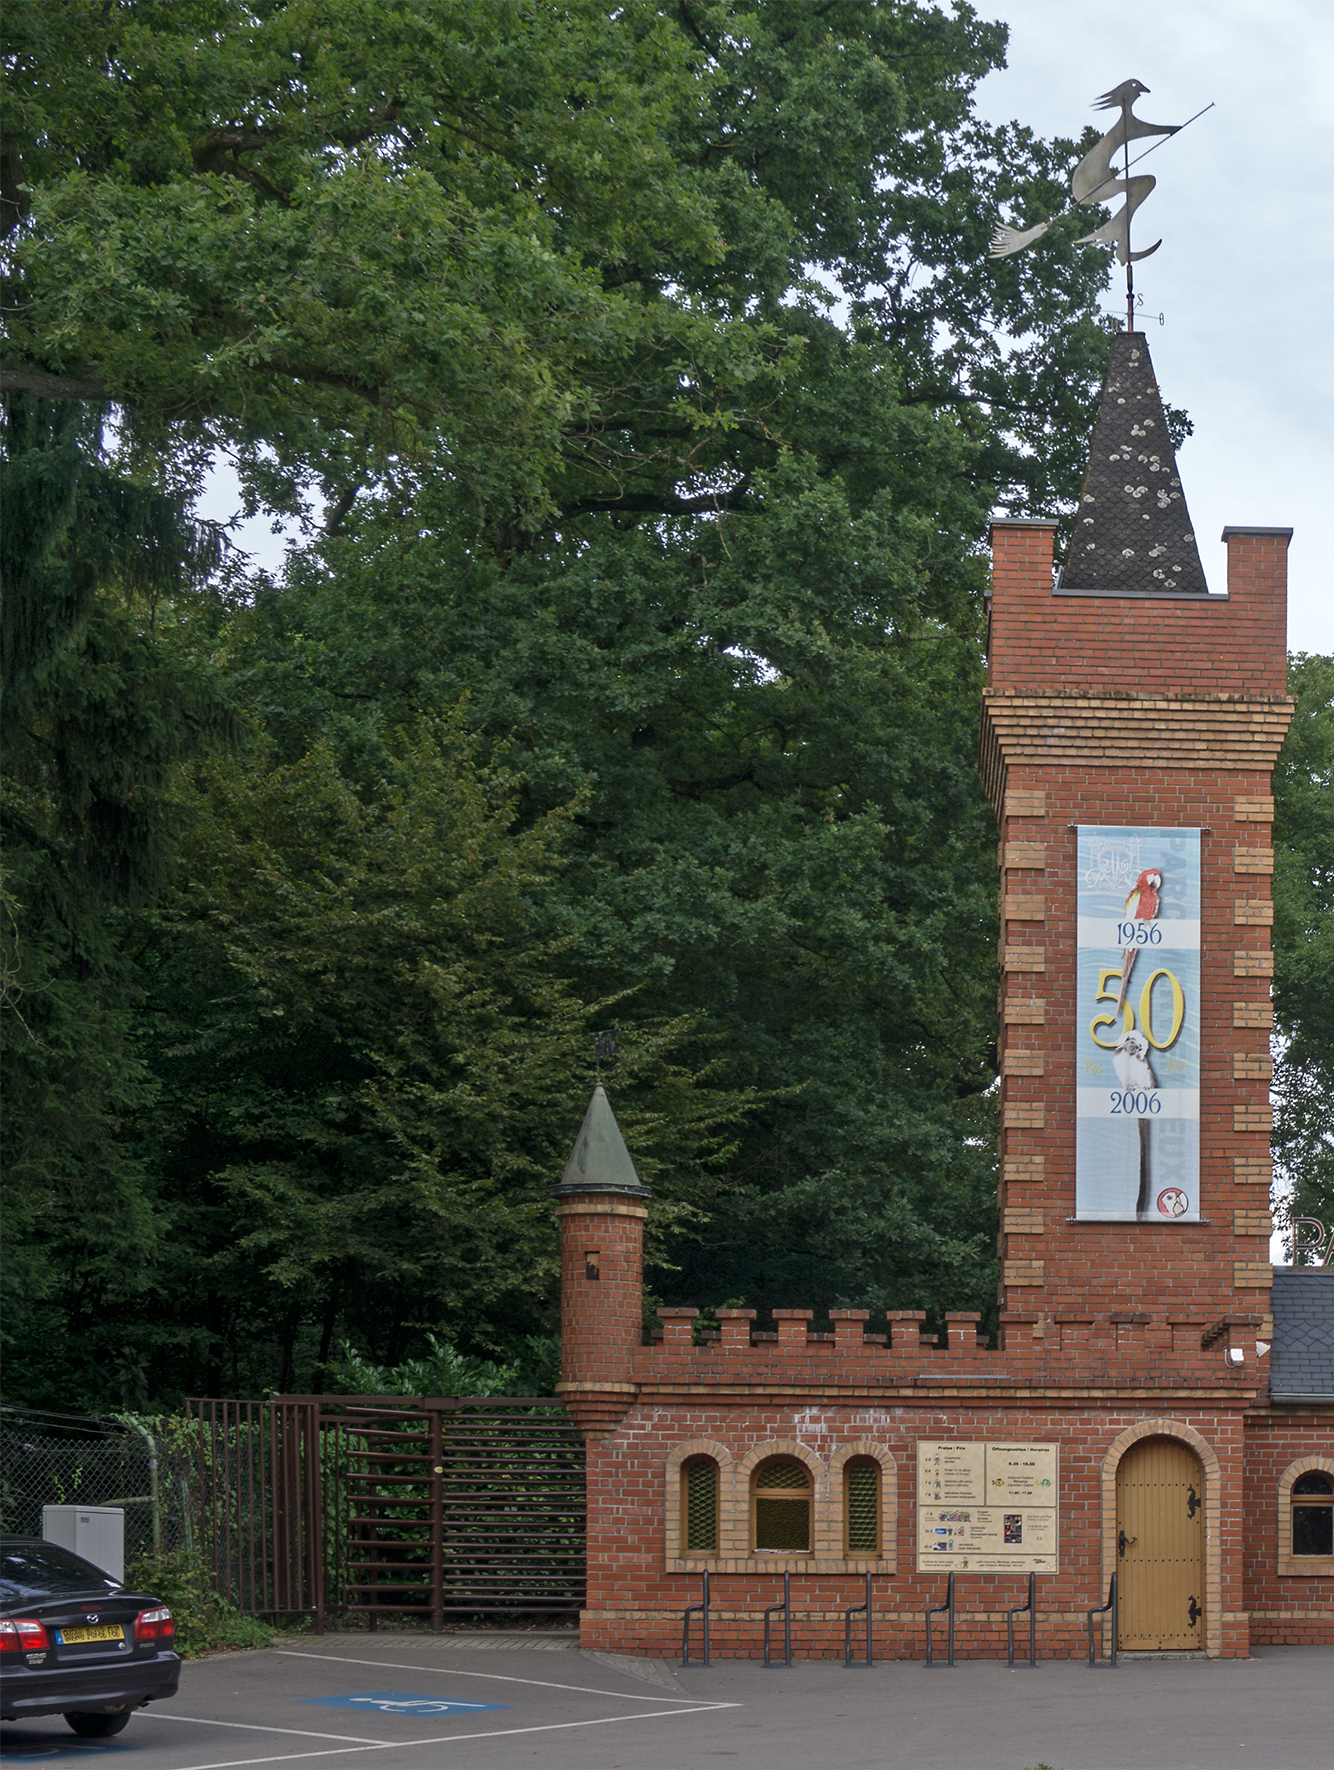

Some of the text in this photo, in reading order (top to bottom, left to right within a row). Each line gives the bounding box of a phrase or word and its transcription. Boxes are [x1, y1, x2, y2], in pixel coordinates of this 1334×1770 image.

[1117, 922, 1162, 946] 1956
[1089, 968, 1184, 1049] 50
[1110, 1091, 1161, 1114] 2006
